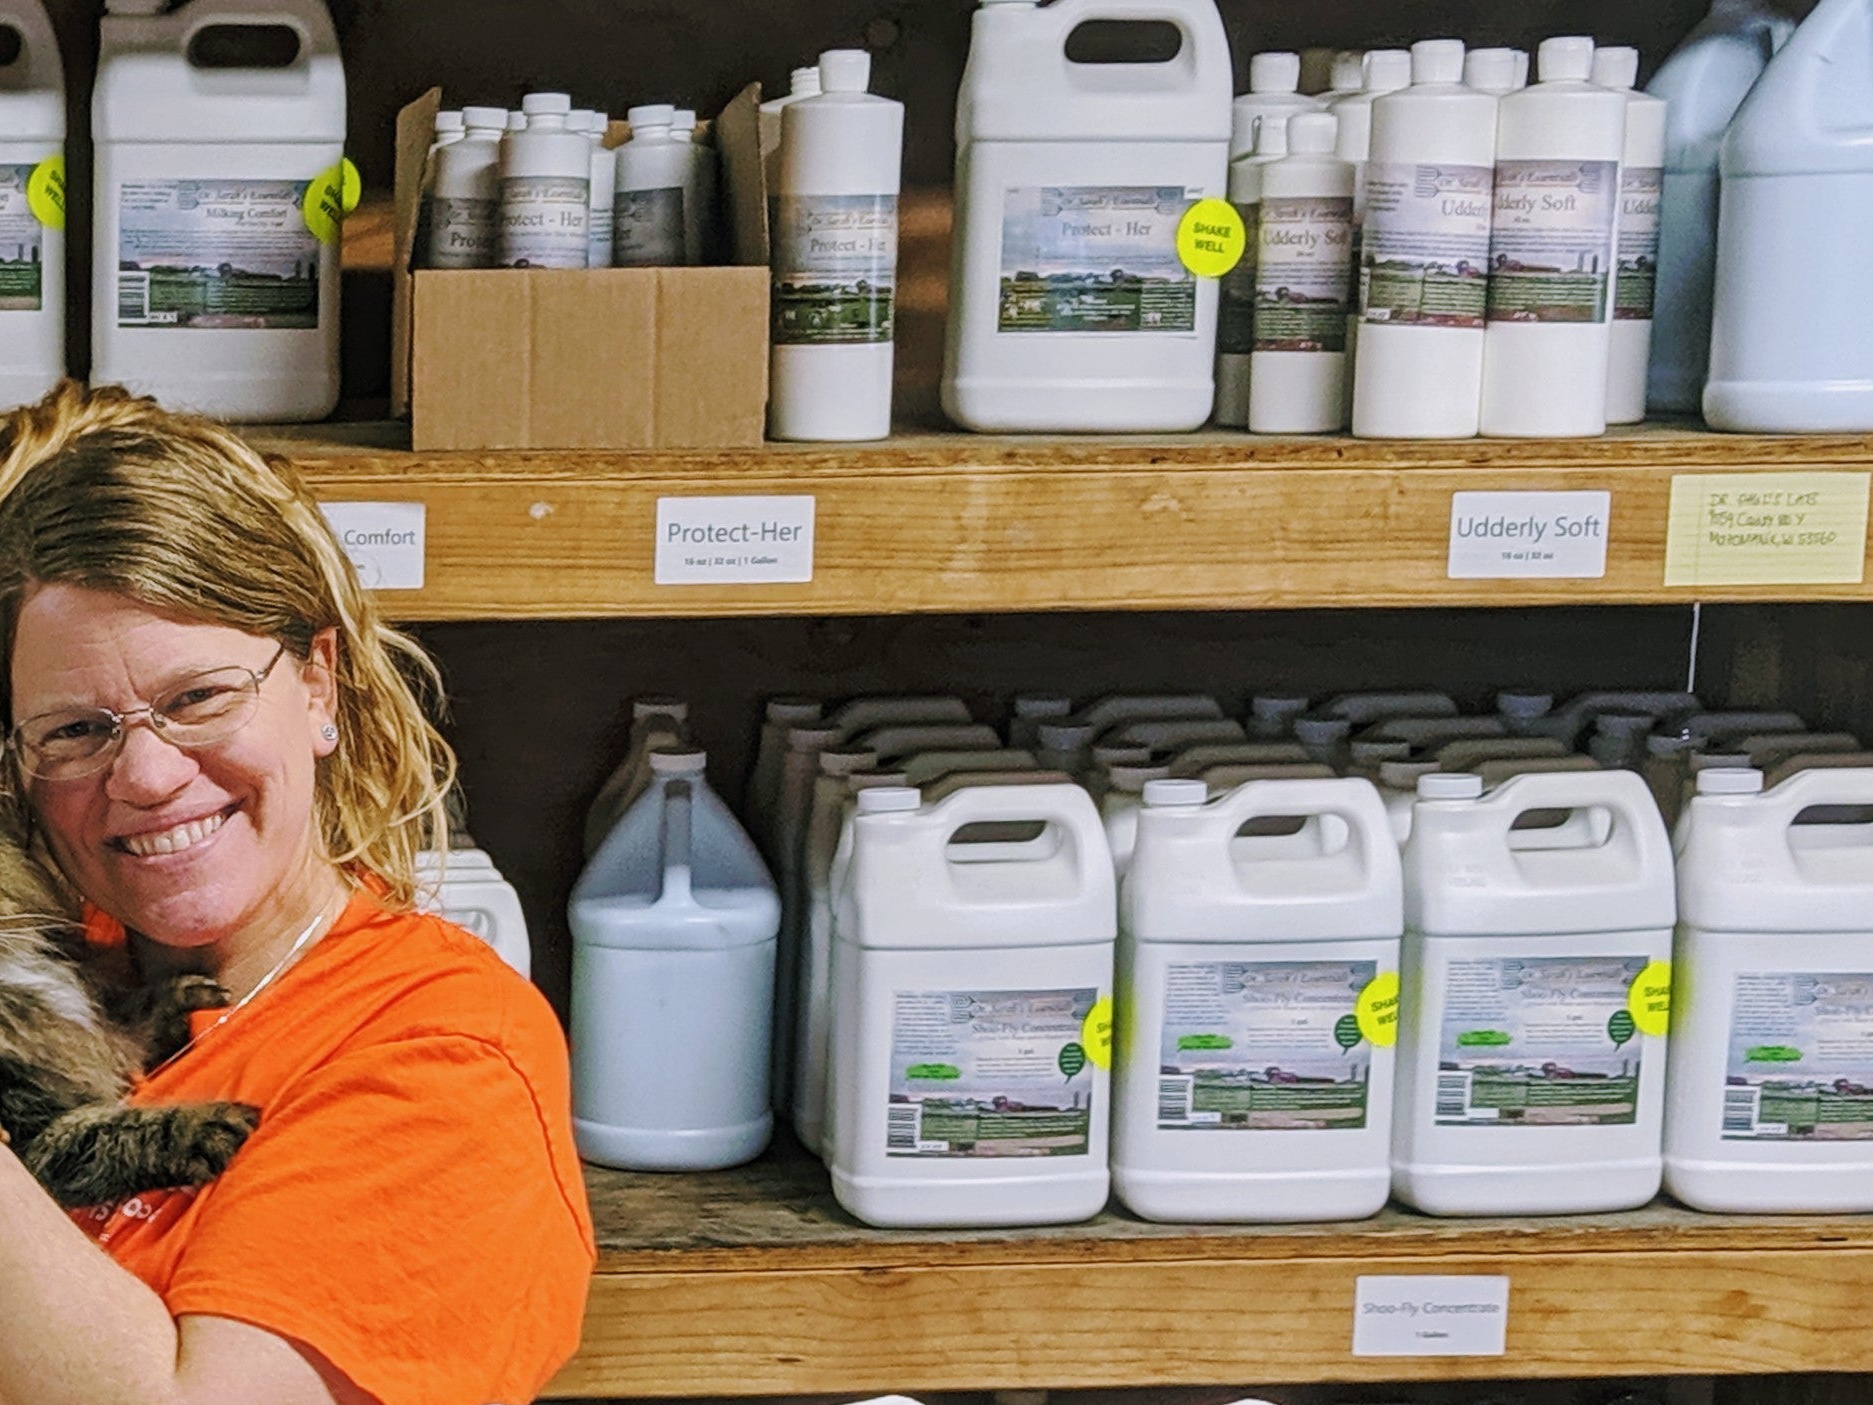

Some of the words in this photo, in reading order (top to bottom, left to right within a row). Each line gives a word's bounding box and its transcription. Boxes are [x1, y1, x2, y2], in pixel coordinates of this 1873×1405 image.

[1541, 196, 1576, 211] Soft
[561, 211, 582, 225] Her
[1192, 222, 1231, 239] SHAKE
[1194, 239, 1225, 254] WELL
[667, 521, 803, 544] Protect-Her
[1457, 516, 1548, 542] Udderly
[1554, 516, 1600, 538] Soft
[344, 528, 416, 547] Comfort
[750, 555, 778, 565] Gallon
[1362, 1302, 1420, 1316] Shoo-Fly
[1422, 1302, 1500, 1314] Concentrate
